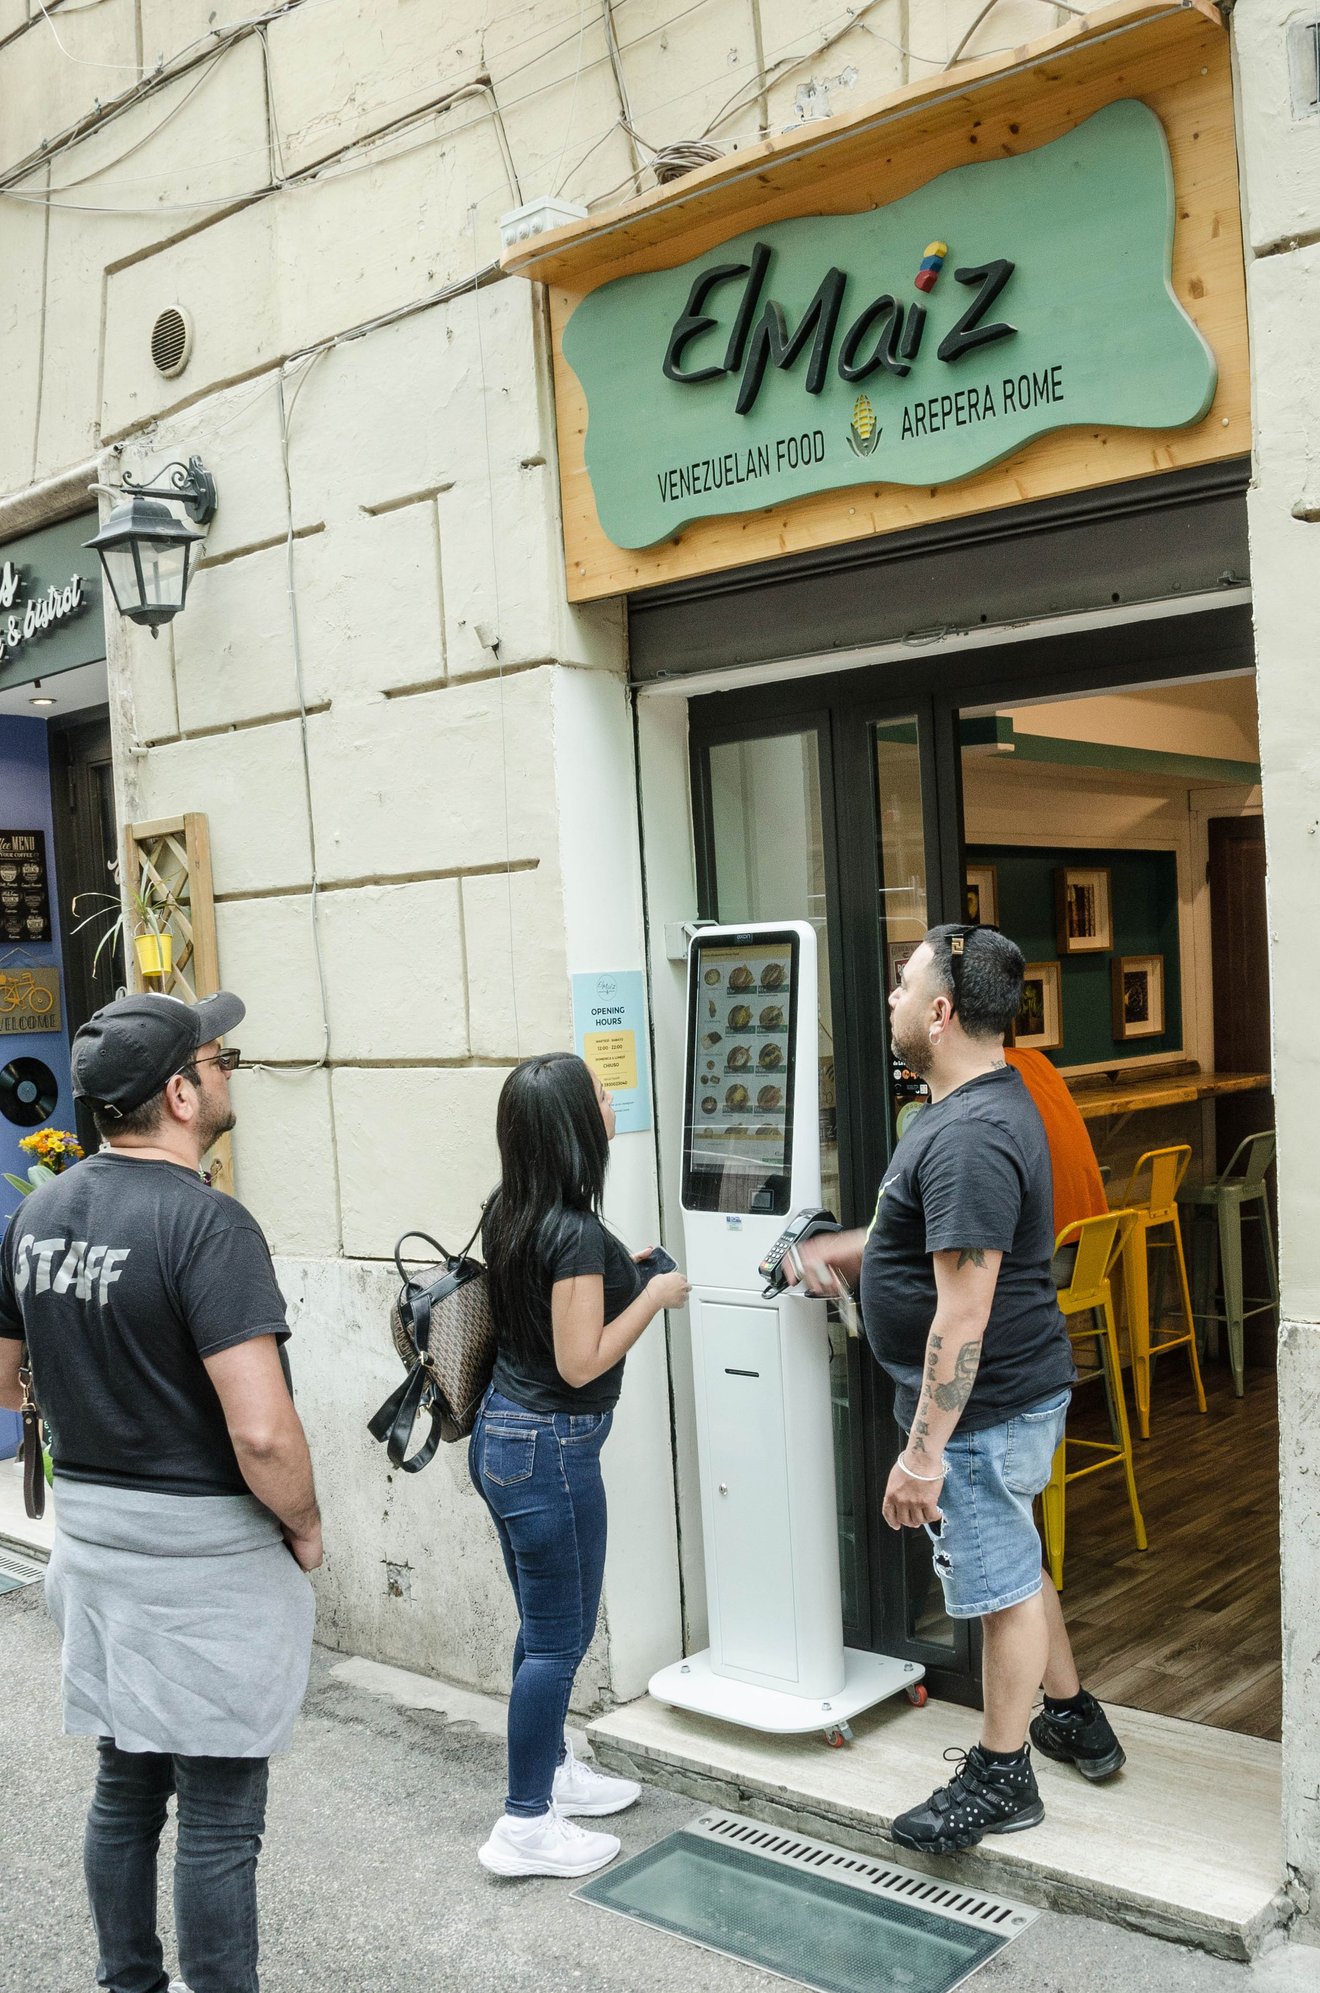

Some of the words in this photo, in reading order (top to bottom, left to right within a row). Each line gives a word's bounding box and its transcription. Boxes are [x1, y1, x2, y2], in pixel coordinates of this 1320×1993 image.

[901, 384, 996, 441] AREPERA
[1003, 365, 1065, 415] ROME
[657, 443, 770, 504] VENEZUELAN
[776, 429, 825, 472] FOOD
[7, 615, 21, 647] &
[23, 573, 81, 639] bistrot
[12, 836, 35, 851] MENU
[0, 1014, 57, 1031] ELCOME
[590, 1006, 626, 1016] OPENING
[595, 1017, 622, 1026] HOURS
[14, 1233, 132, 1307] STAFF
